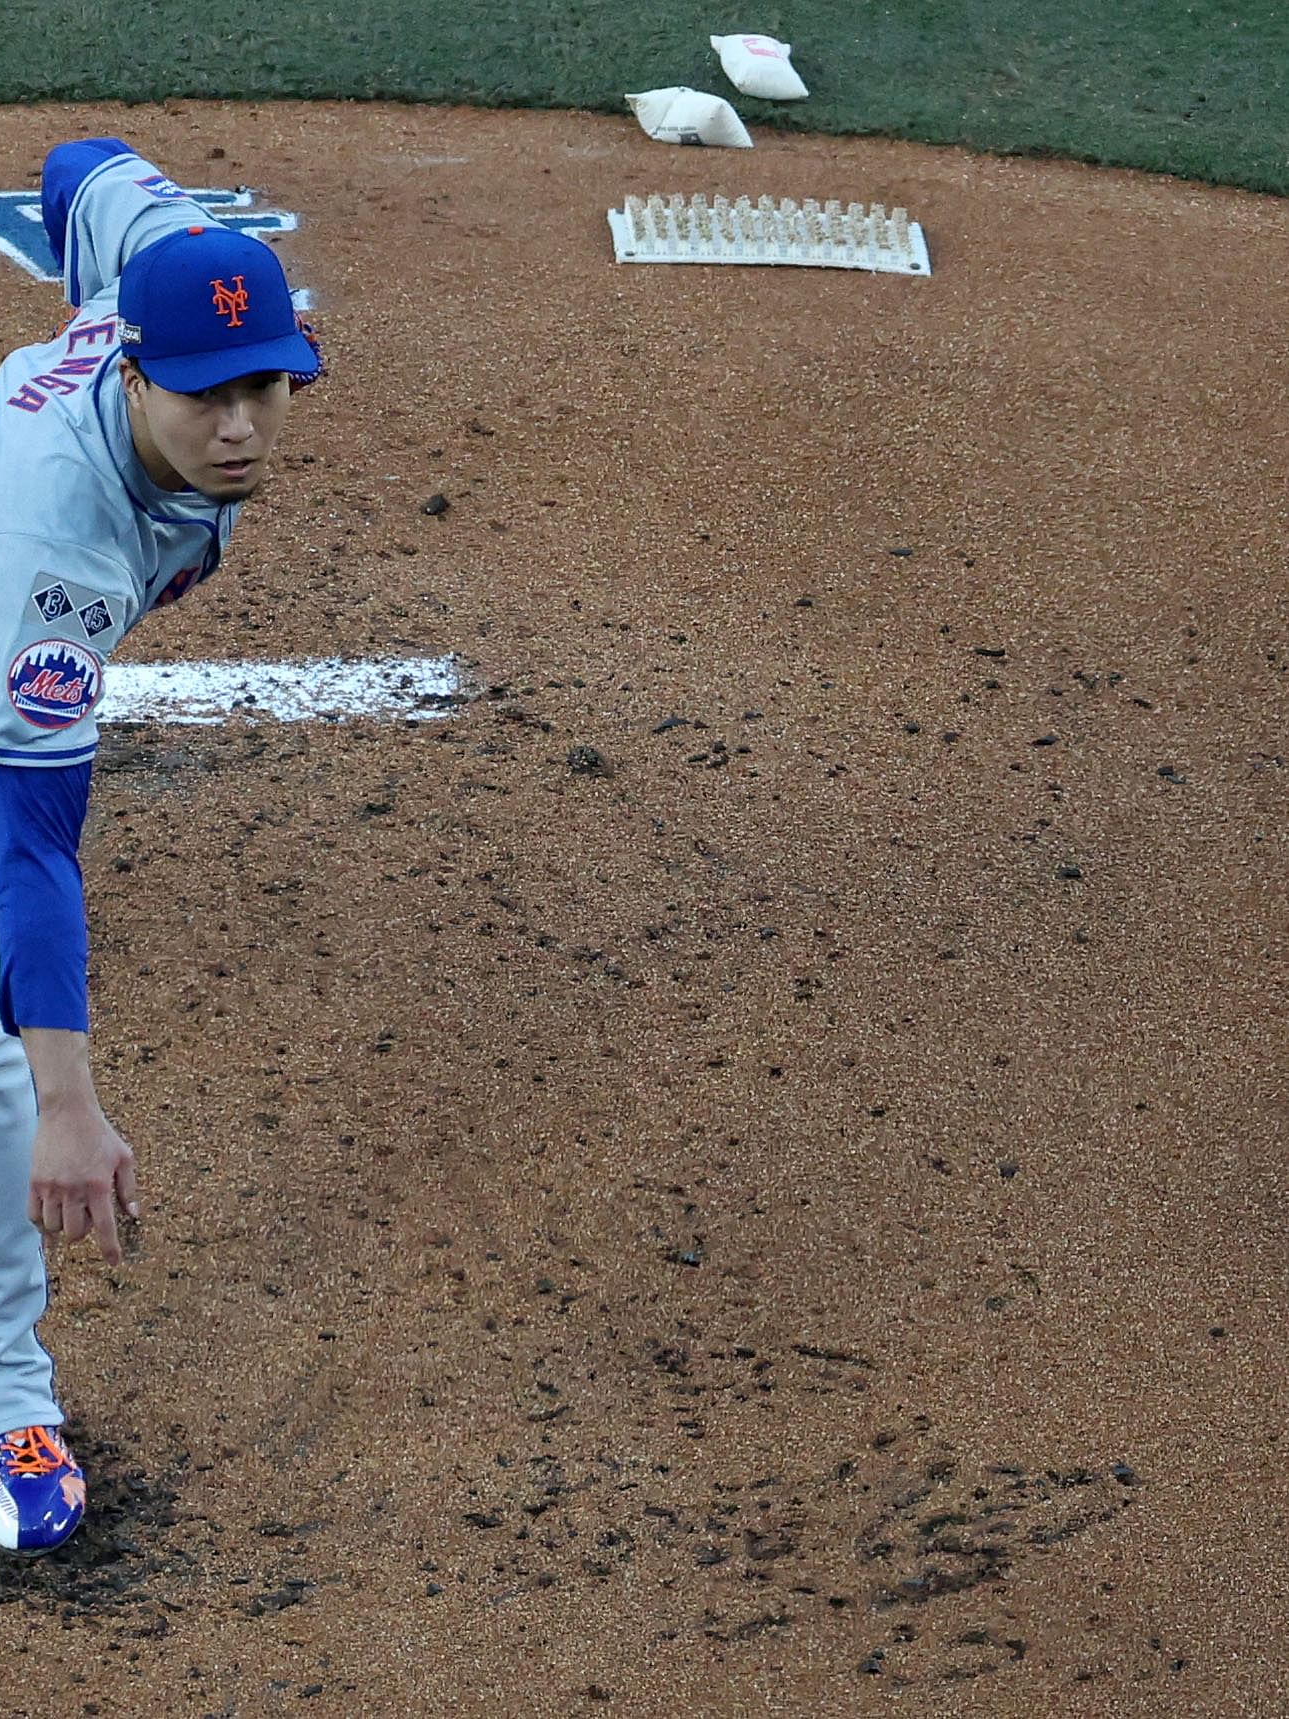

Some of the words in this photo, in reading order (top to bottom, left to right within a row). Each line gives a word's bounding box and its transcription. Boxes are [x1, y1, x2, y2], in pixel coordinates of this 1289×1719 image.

[210, 275, 250, 327] NY
[7, 312, 118, 413] ENGA
[19, 669, 86, 704] Mets
